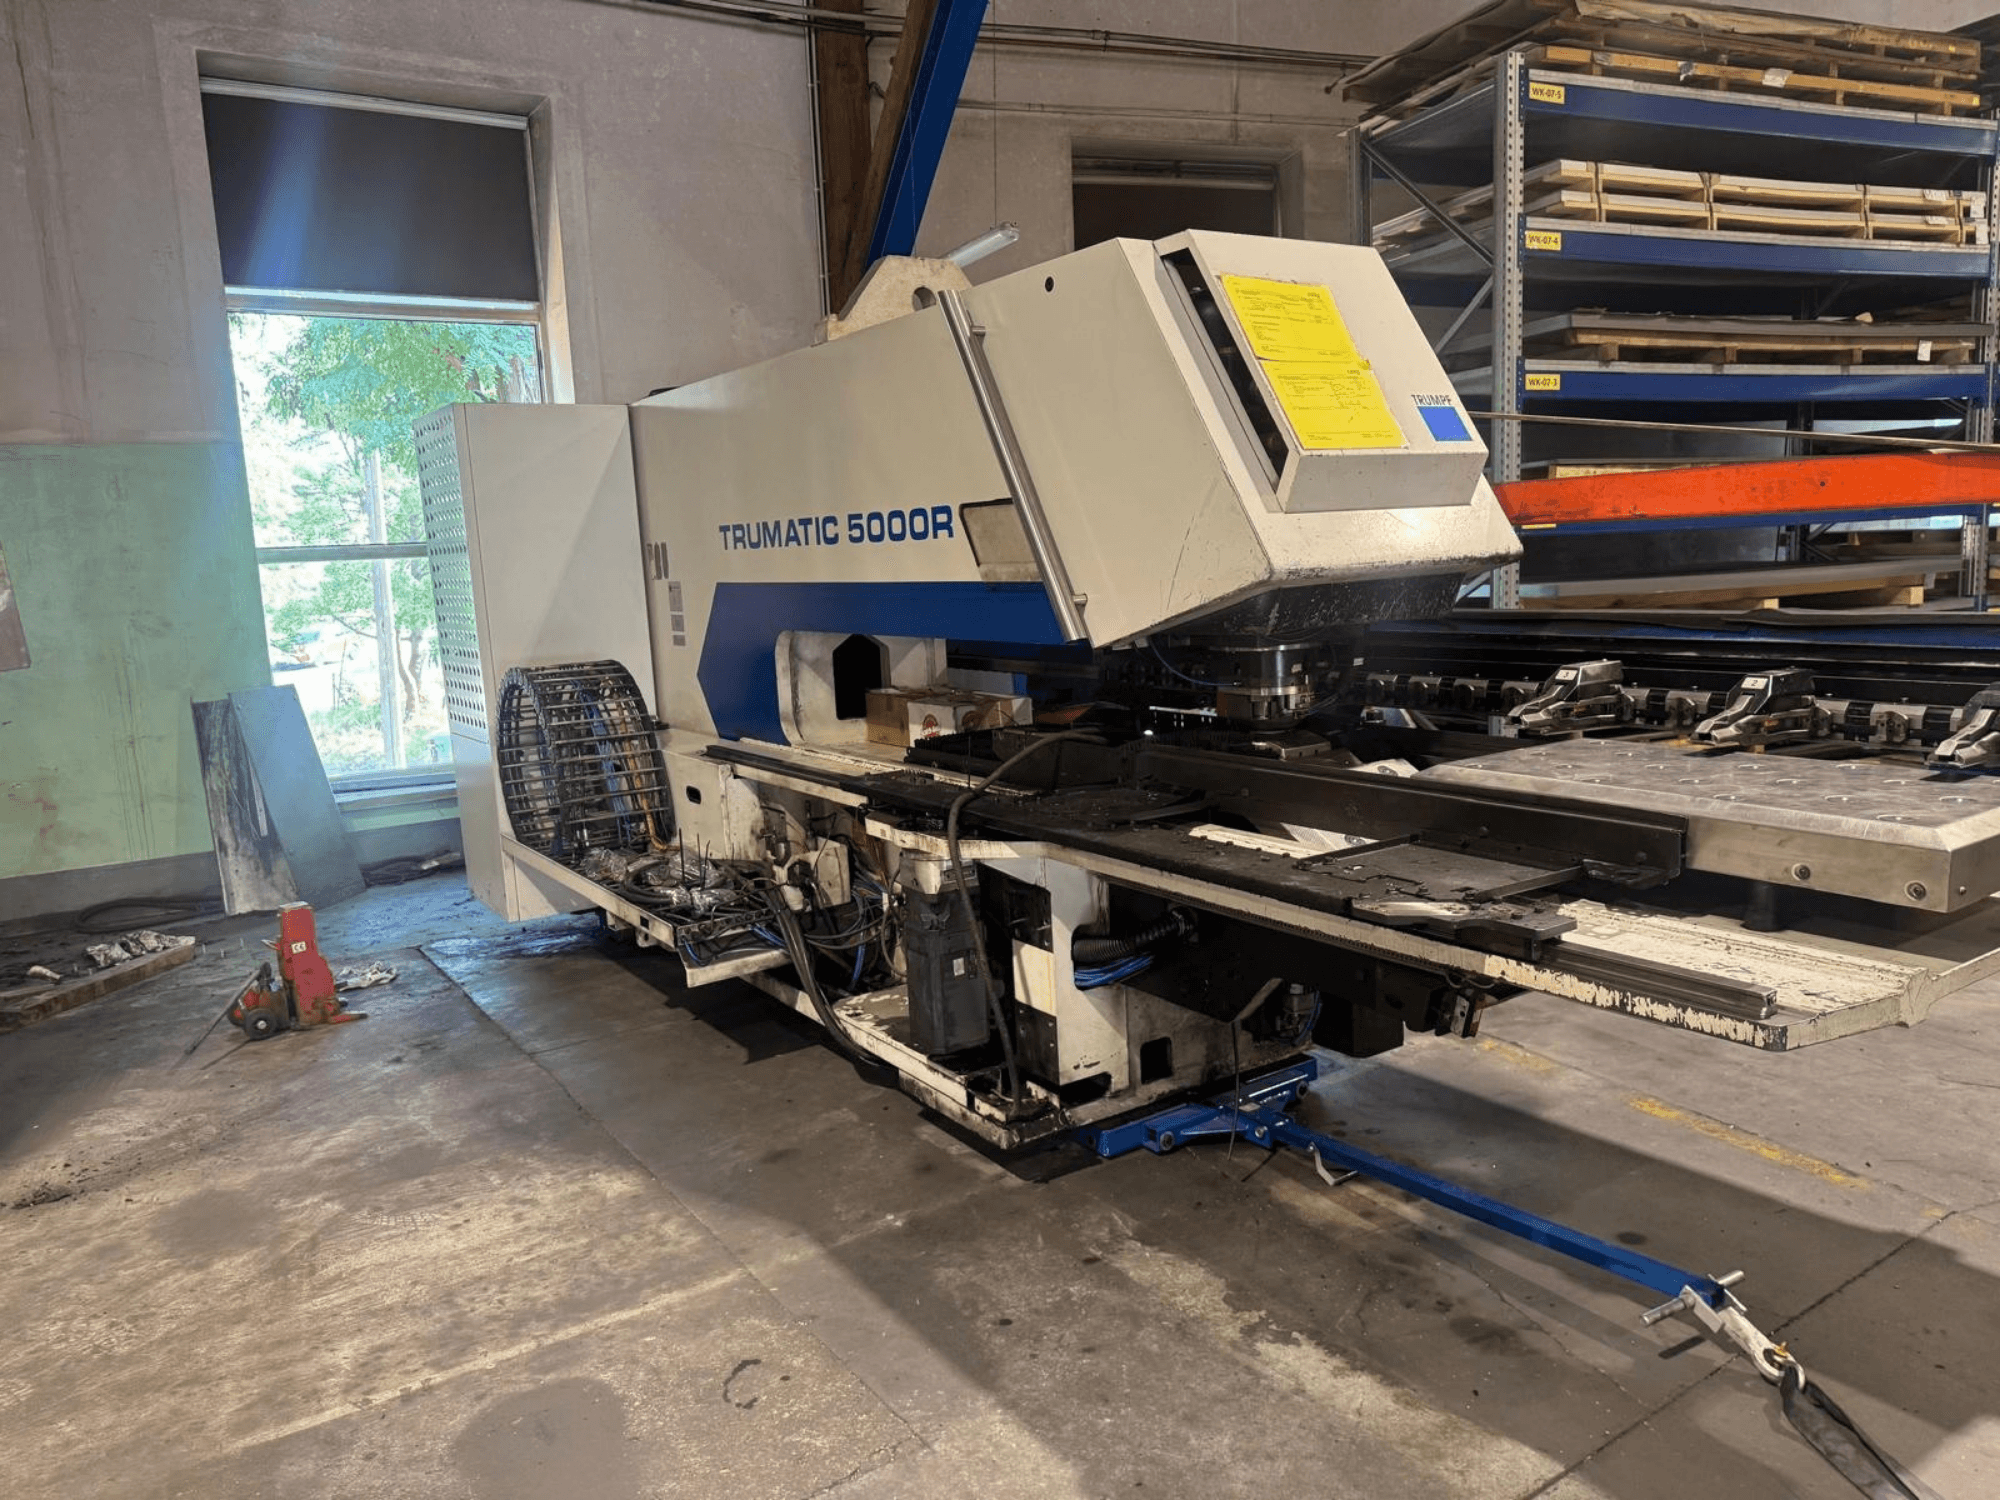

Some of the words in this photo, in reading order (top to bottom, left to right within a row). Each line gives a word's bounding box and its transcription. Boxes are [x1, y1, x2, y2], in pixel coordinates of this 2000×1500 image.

[1411, 394, 1452, 406] TRUMPF
[719, 515, 839, 550] TRUMATIC
[847, 505, 954, 543] 5000R
